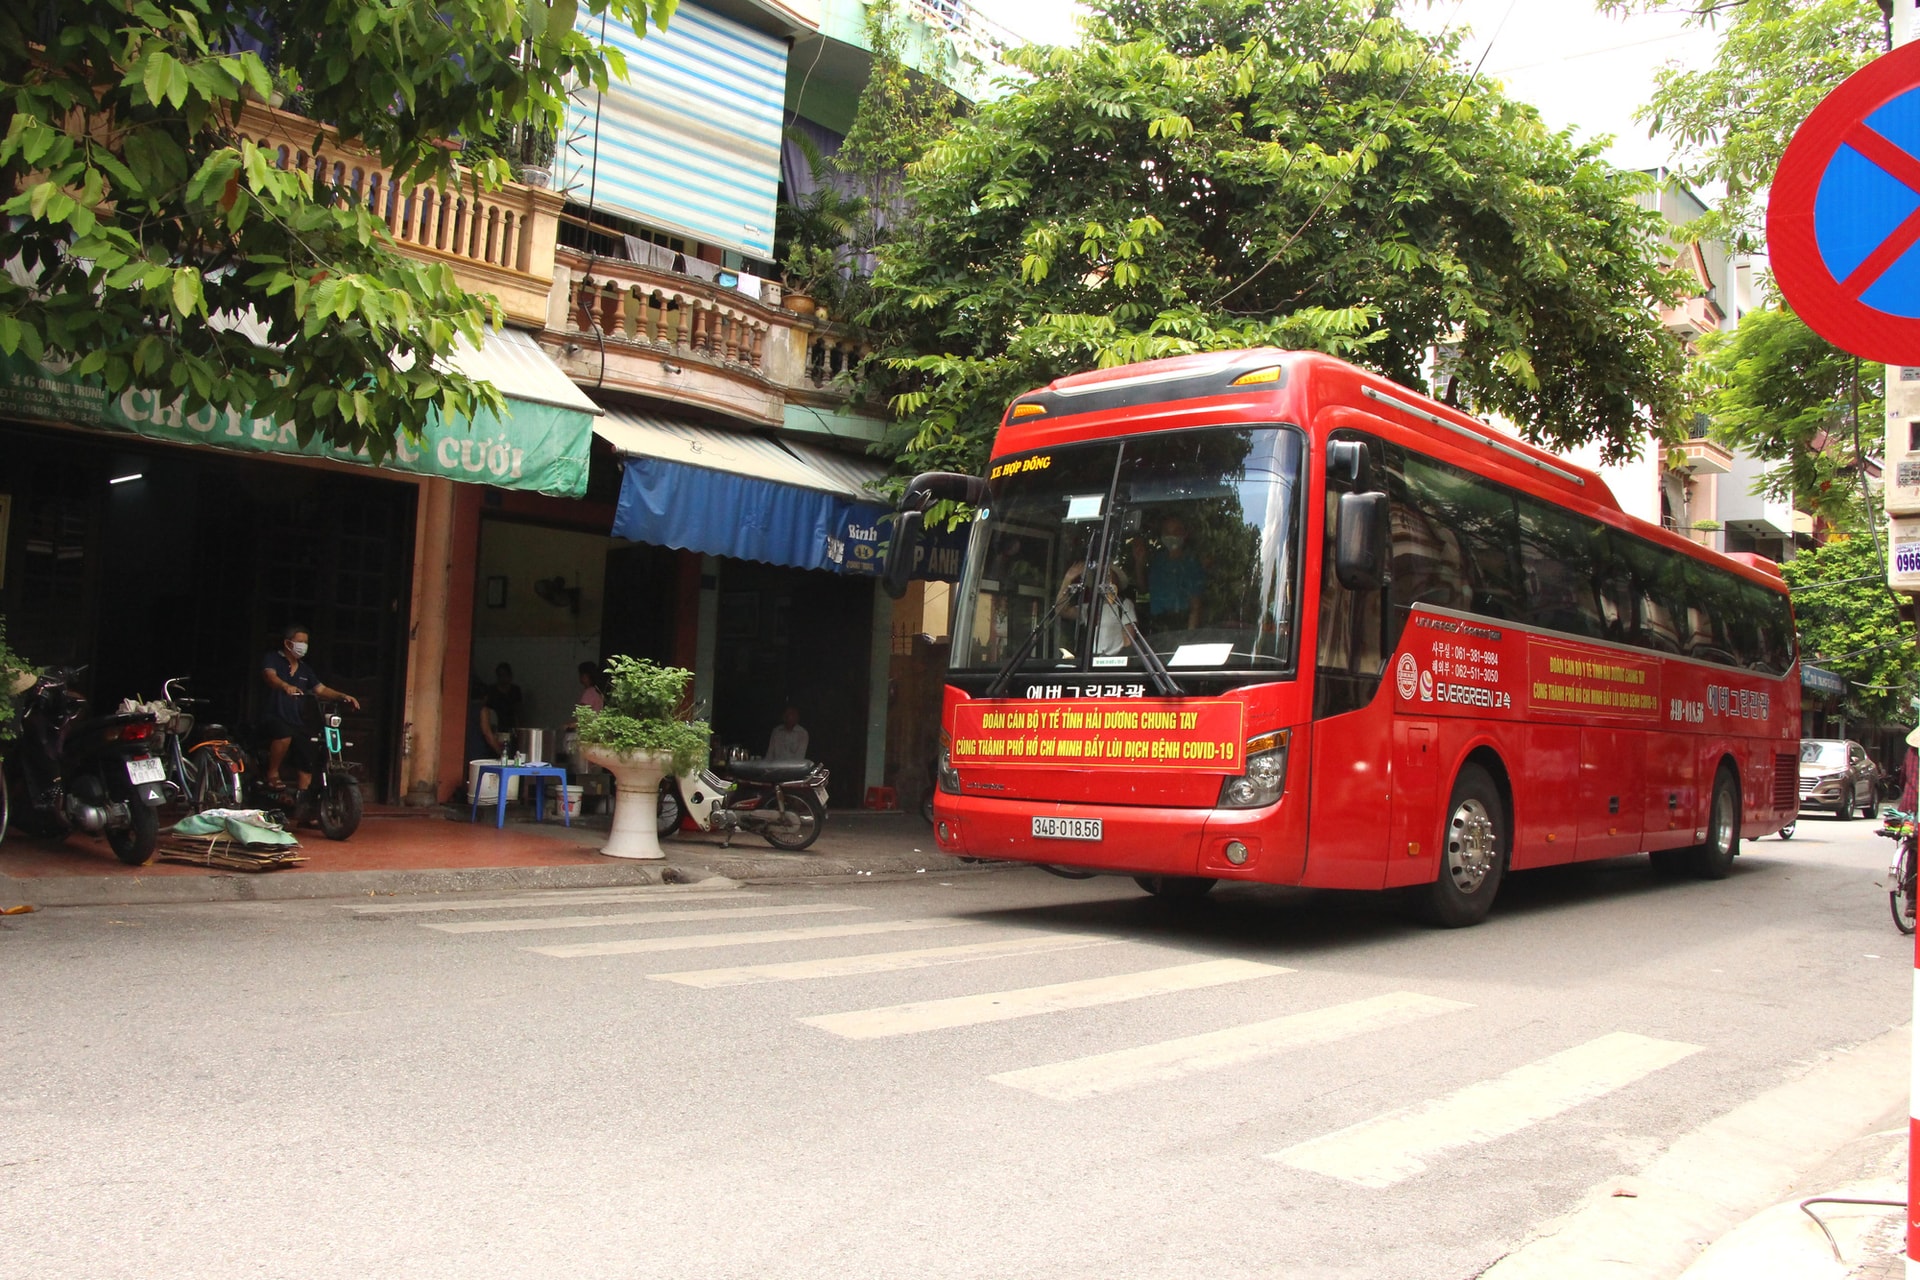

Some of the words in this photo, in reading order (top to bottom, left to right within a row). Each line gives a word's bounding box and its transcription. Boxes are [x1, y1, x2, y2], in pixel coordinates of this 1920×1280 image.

[437, 433, 525, 478] CƯỚI
[991, 465, 1002, 479] XE
[1002, 460, 1022, 477] HỢP
[1022, 455, 1051, 472] ĐỒNG
[1436, 682, 1495, 708] EVERGREEN
[982, 709, 1006, 729] ĐOÀN
[1007, 709, 1025, 729] CÁN
[1026, 709, 1039, 732] BỘ
[1041, 712, 1048, 729] Y
[1049, 707, 1061, 729] TẾ
[1062, 706, 1084, 729] TỈNH
[1085, 706, 1102, 729] HẢI
[1104, 711, 1139, 729] DƯƠNG
[1140, 711, 1177, 730] CHUNG
[1179, 712, 1198, 730] TAY
[956, 736, 977, 755] CÙNG
[978, 736, 1005, 756] THÀNH
[1006, 734, 1026, 756] PHỐ
[1040, 736, 1057, 757] CHÍ
[1057, 740, 1083, 757] MINH
[1084, 733, 1105, 757] ĐẨY
[1106, 736, 1123, 757] LÙI
[1124, 741, 1149, 762] DỊCH
[1151, 737, 1180, 762] BỆNH
[1182, 741, 1234, 760] COVID-19
[1034, 818, 1100, 838] 34B-018.56
